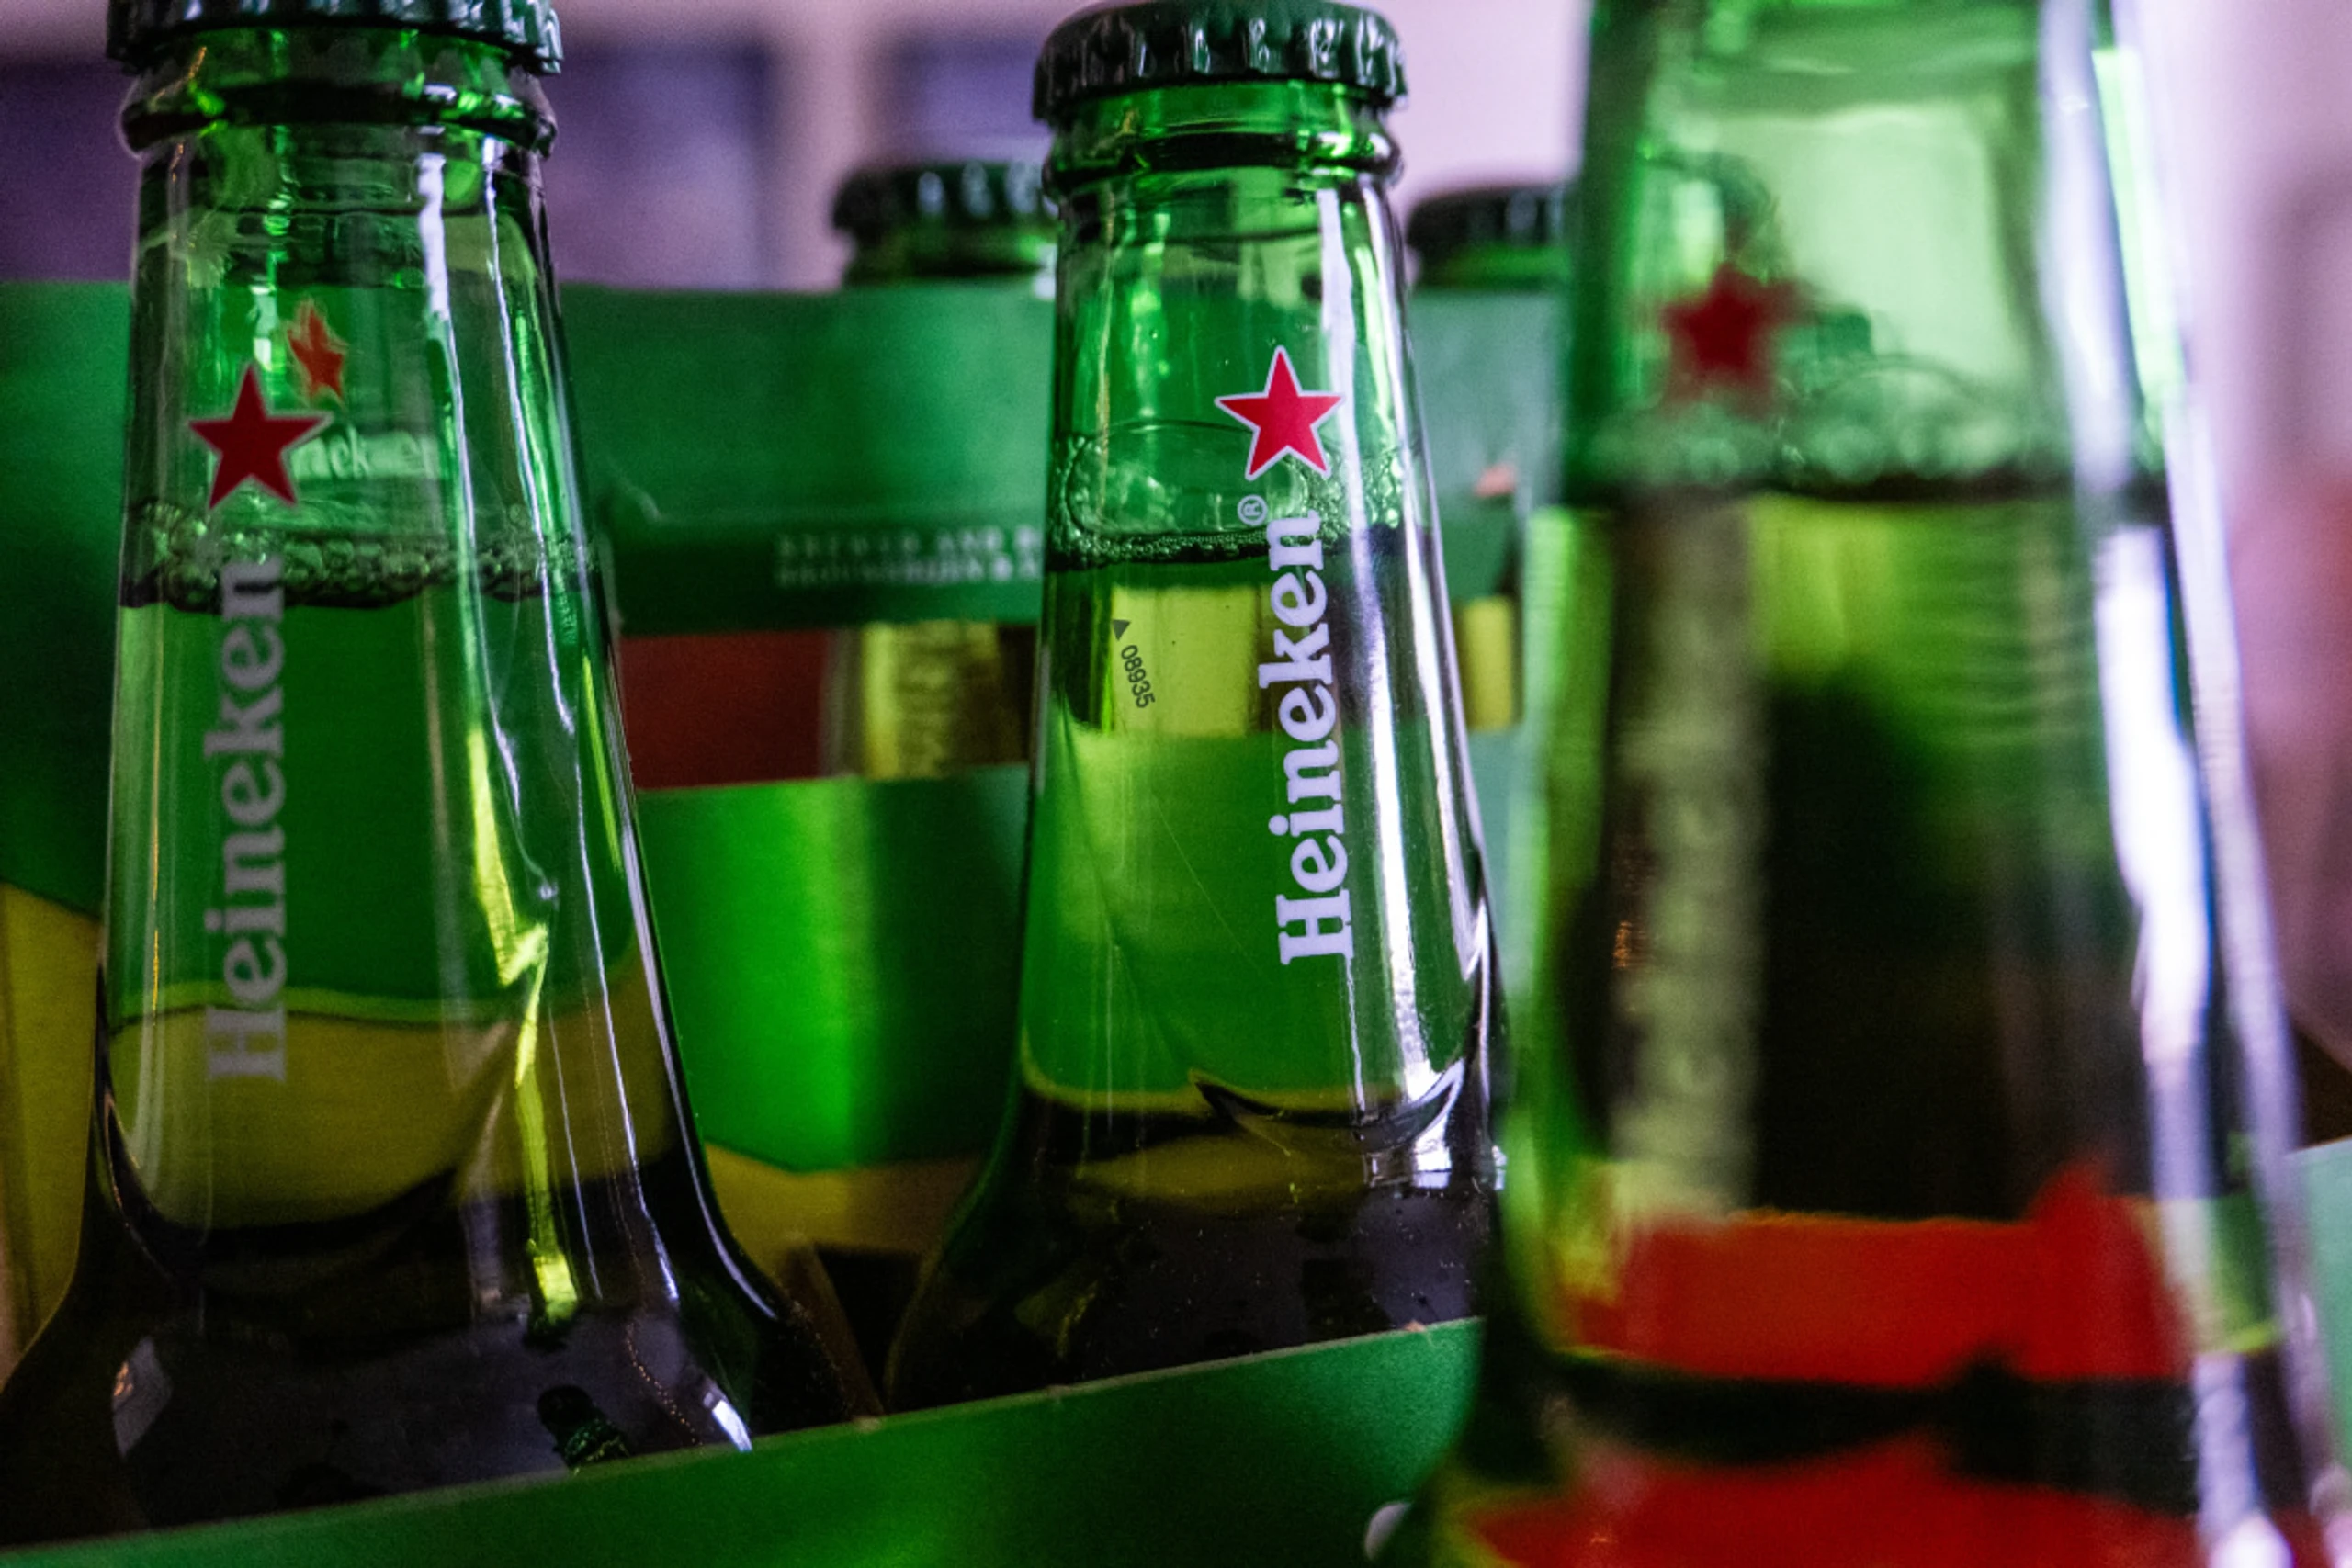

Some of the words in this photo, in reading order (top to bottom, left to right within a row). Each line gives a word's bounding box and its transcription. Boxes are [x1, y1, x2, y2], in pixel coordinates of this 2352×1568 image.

[204, 556, 287, 1082] Heineken
[1121, 645, 1156, 708] 08935
[1258, 509, 1354, 965] Heineken
